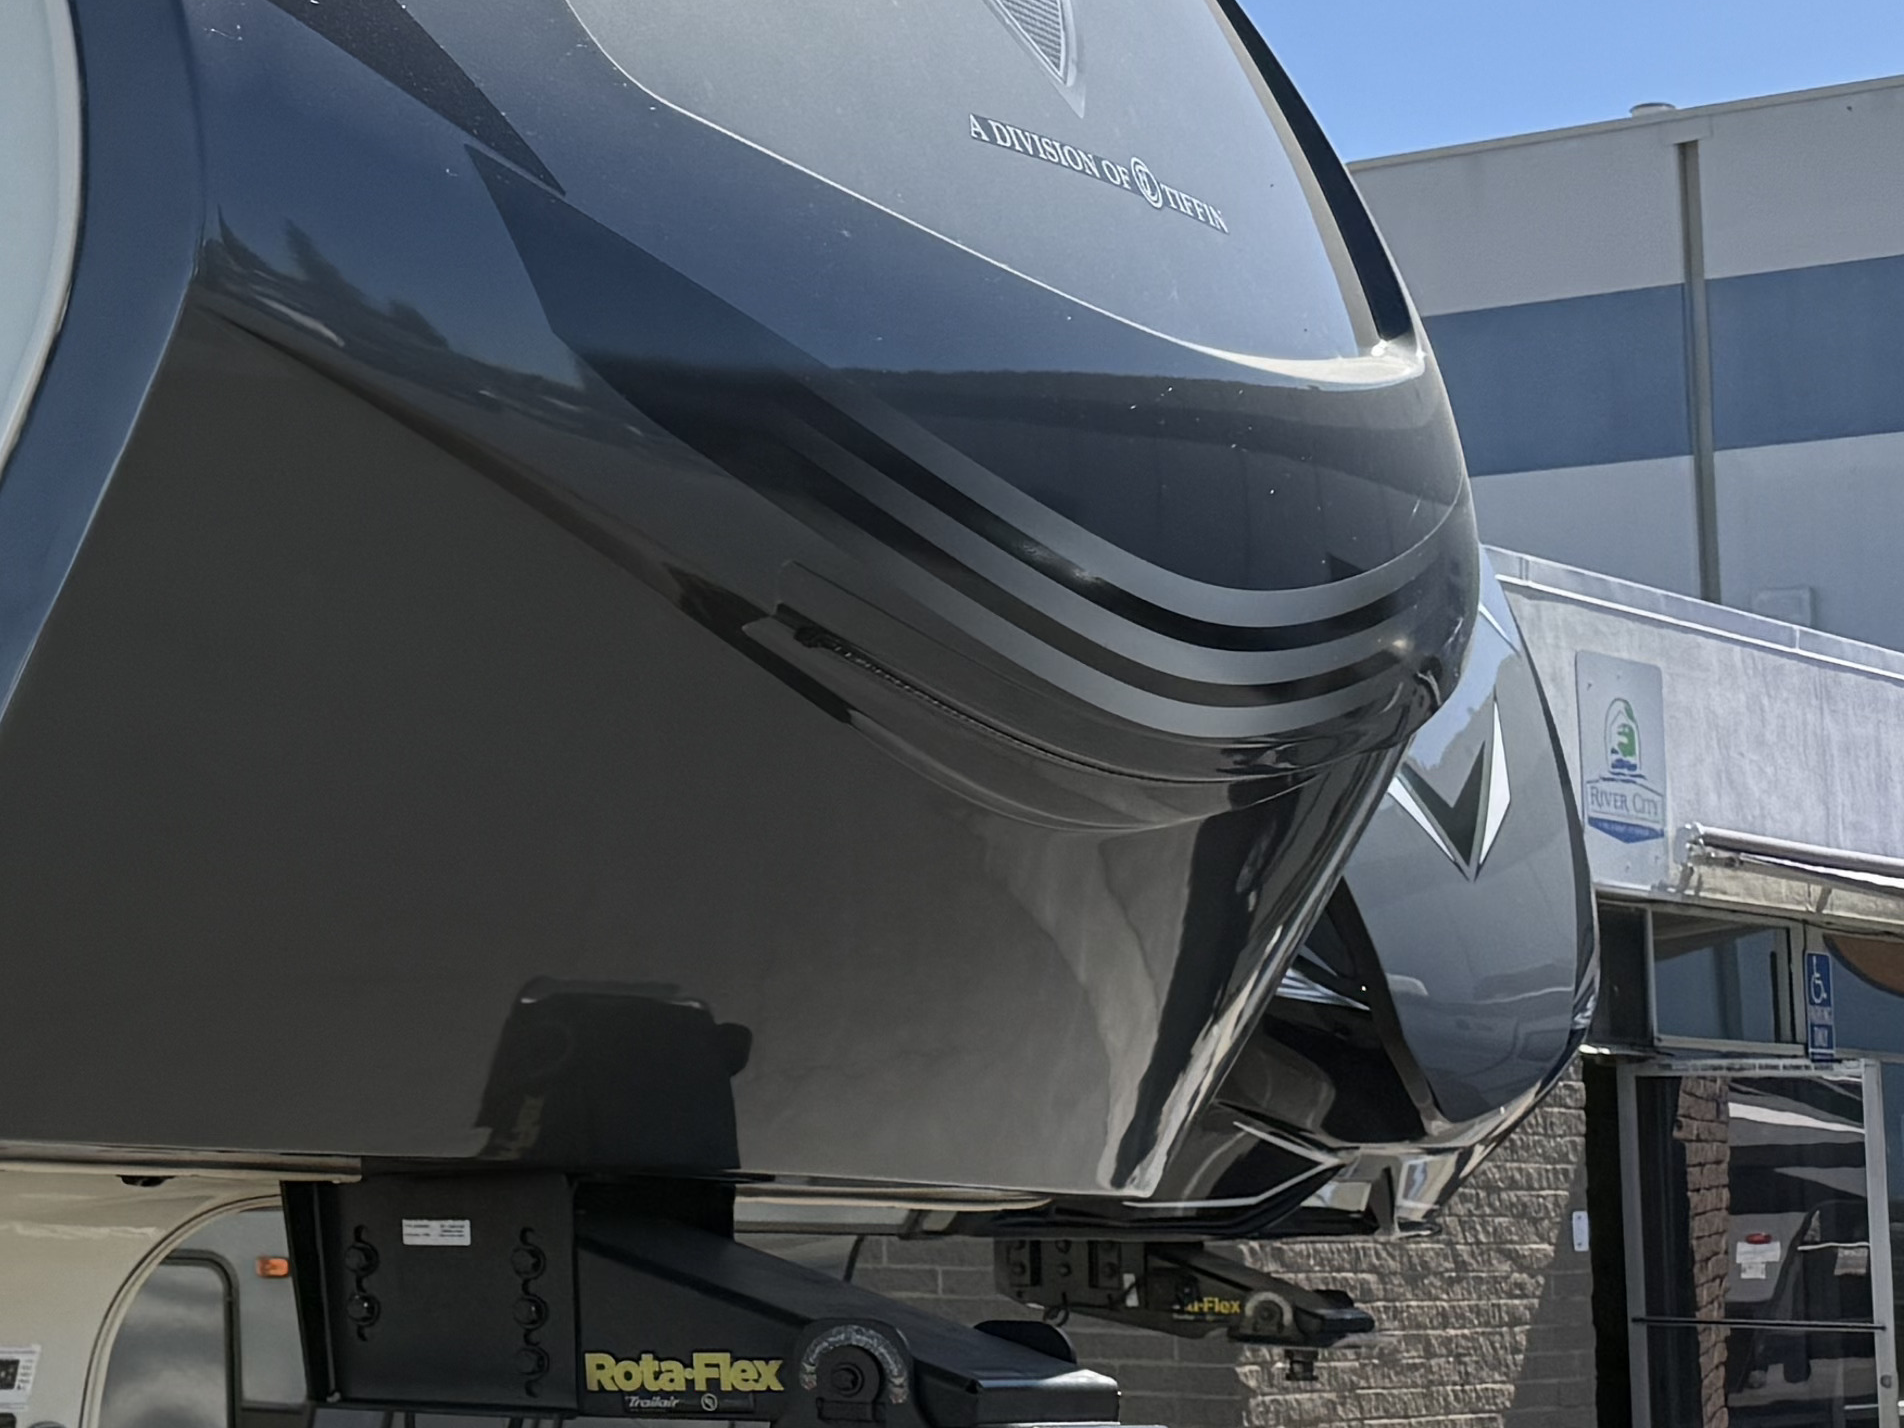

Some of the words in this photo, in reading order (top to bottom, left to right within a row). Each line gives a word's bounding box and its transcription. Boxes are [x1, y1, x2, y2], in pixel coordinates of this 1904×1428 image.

[969, 113, 990, 142] A
[987, 119, 1101, 178] DIVISION
[1101, 160, 1132, 190] OF
[1159, 183, 1230, 234] TIFFIN
[1590, 785, 1630, 814] RIVER
